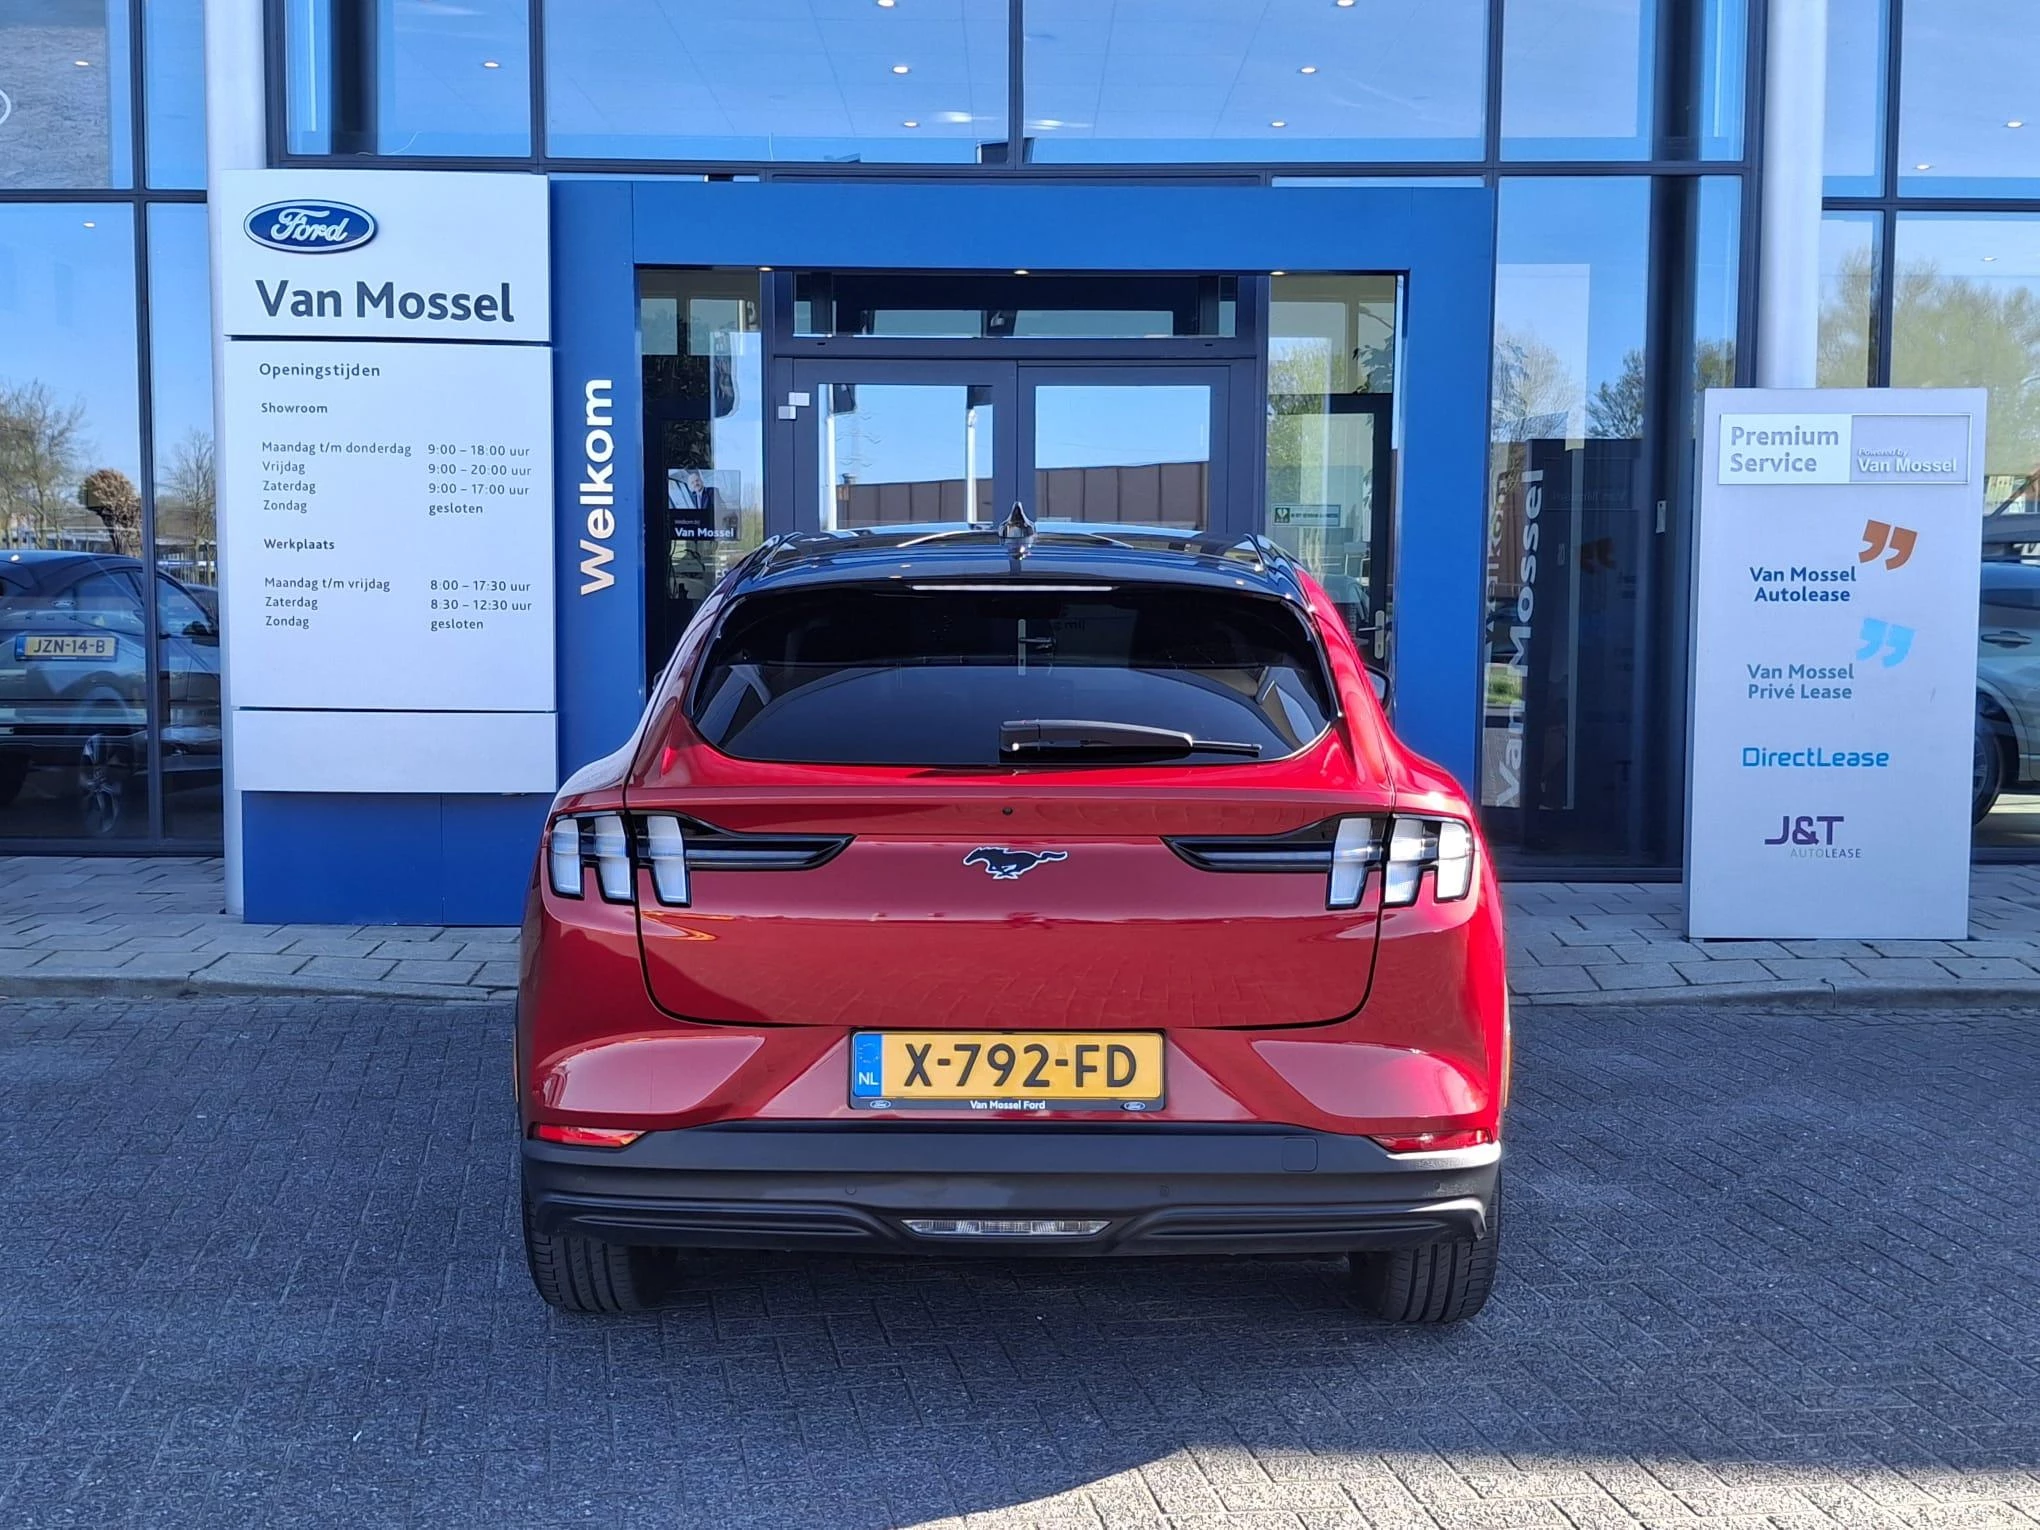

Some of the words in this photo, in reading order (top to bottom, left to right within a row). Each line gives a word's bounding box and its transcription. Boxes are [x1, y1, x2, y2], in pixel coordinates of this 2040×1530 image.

[255, 280, 341, 317] Van
[357, 281, 514, 322] Mossel
[260, 363, 379, 379] Openingstijden
[262, 402, 327, 413] Showroom
[1732, 425, 1838, 445] Premium
[263, 442, 315, 455] Maandag
[320, 442, 341, 452] t/m
[346, 442, 411, 457] donderdag
[428, 444, 456, 454] 9:00
[471, 445, 505, 456] 18:00
[263, 461, 305, 475] Vrijdag
[429, 464, 456, 474] 9:00
[471, 465, 506, 475] 20:00
[1731, 452, 1816, 472] Service
[1858, 457, 1890, 473] Van
[1895, 457, 1957, 473] Mossel
[264, 480, 316, 494] Zaterdag
[429, 483, 456, 493] 9:00
[472, 484, 504, 494] 17:00
[579, 379, 615, 595] Welkom
[264, 500, 307, 513] Zondag
[429, 503, 483, 516] gesloten
[675, 528, 695, 537] Van
[697, 528, 734, 537] Mossel
[264, 539, 334, 552] Werkplaats
[1506, 469, 1543, 677] Mossel
[1750, 567, 1784, 581] Van
[1791, 566, 1856, 581] Mossel
[265, 577, 318, 591] Maandag
[323, 578, 344, 588] t/m
[348, 579, 390, 592] vrijdag
[431, 580, 458, 590] 8:00
[473, 581, 506, 591] 17:30
[1754, 586, 1850, 601] Autolease
[266, 597, 317, 610] Zaterdag
[431, 599, 458, 609] 8:30
[474, 600, 507, 610] 12:30
[266, 616, 309, 629] Zondag
[431, 619, 483, 631] gesloten
[33, 639, 105, 653] JZN-14-B
[1747, 664, 1782, 679] Van
[1789, 664, 1854, 679] Mossel
[1749, 684, 1795, 699] Privé
[1801, 684, 1852, 699] Lease
[1495, 701, 1526, 807] Van
[1743, 748, 1889, 766] DirectLease
[1765, 816, 1844, 845] J&T
[1791, 848, 1861, 858] AUTOLEASE
[904, 1043, 1136, 1087] X-792-FD
[858, 1073, 879, 1086] NL
[970, 1101, 988, 1110] Van
[990, 1100, 1021, 1110] Mossel
[1023, 1101, 1046, 1110] Ford
